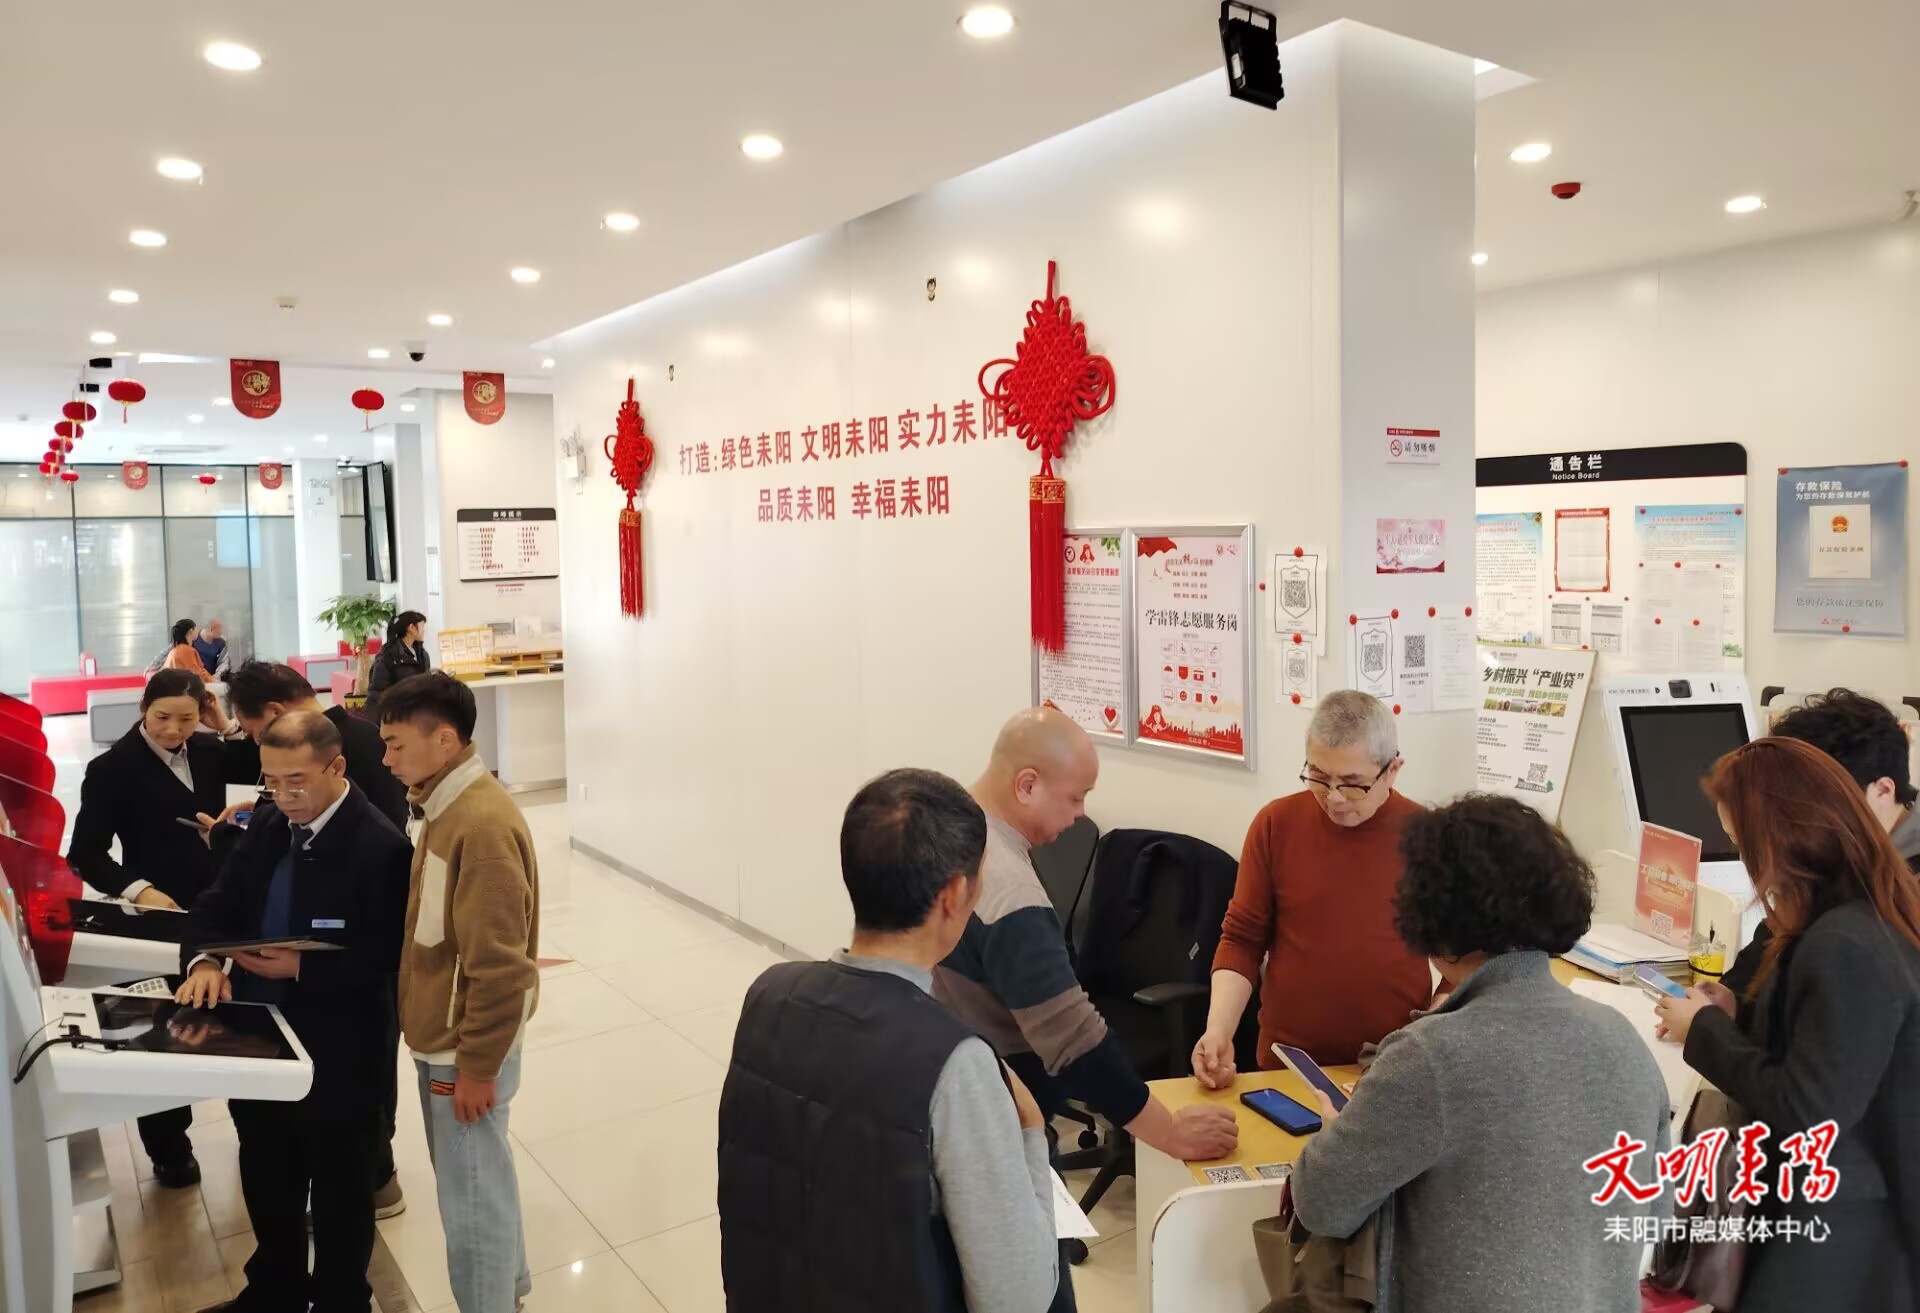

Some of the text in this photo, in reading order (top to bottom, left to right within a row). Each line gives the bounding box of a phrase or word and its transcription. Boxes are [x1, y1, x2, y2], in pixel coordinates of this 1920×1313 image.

[801, 415, 889, 463] 文明耒阳
[897, 397, 1008, 451] 实力耒阳
[1550, 454, 1602, 471] 通告栏
[1795, 481, 1843, 492] 存款保险
[757, 474, 950, 523] 品质耒阳 幸福耒阳
[1145, 609, 1238, 632] 学雷锋志愿服务岗
